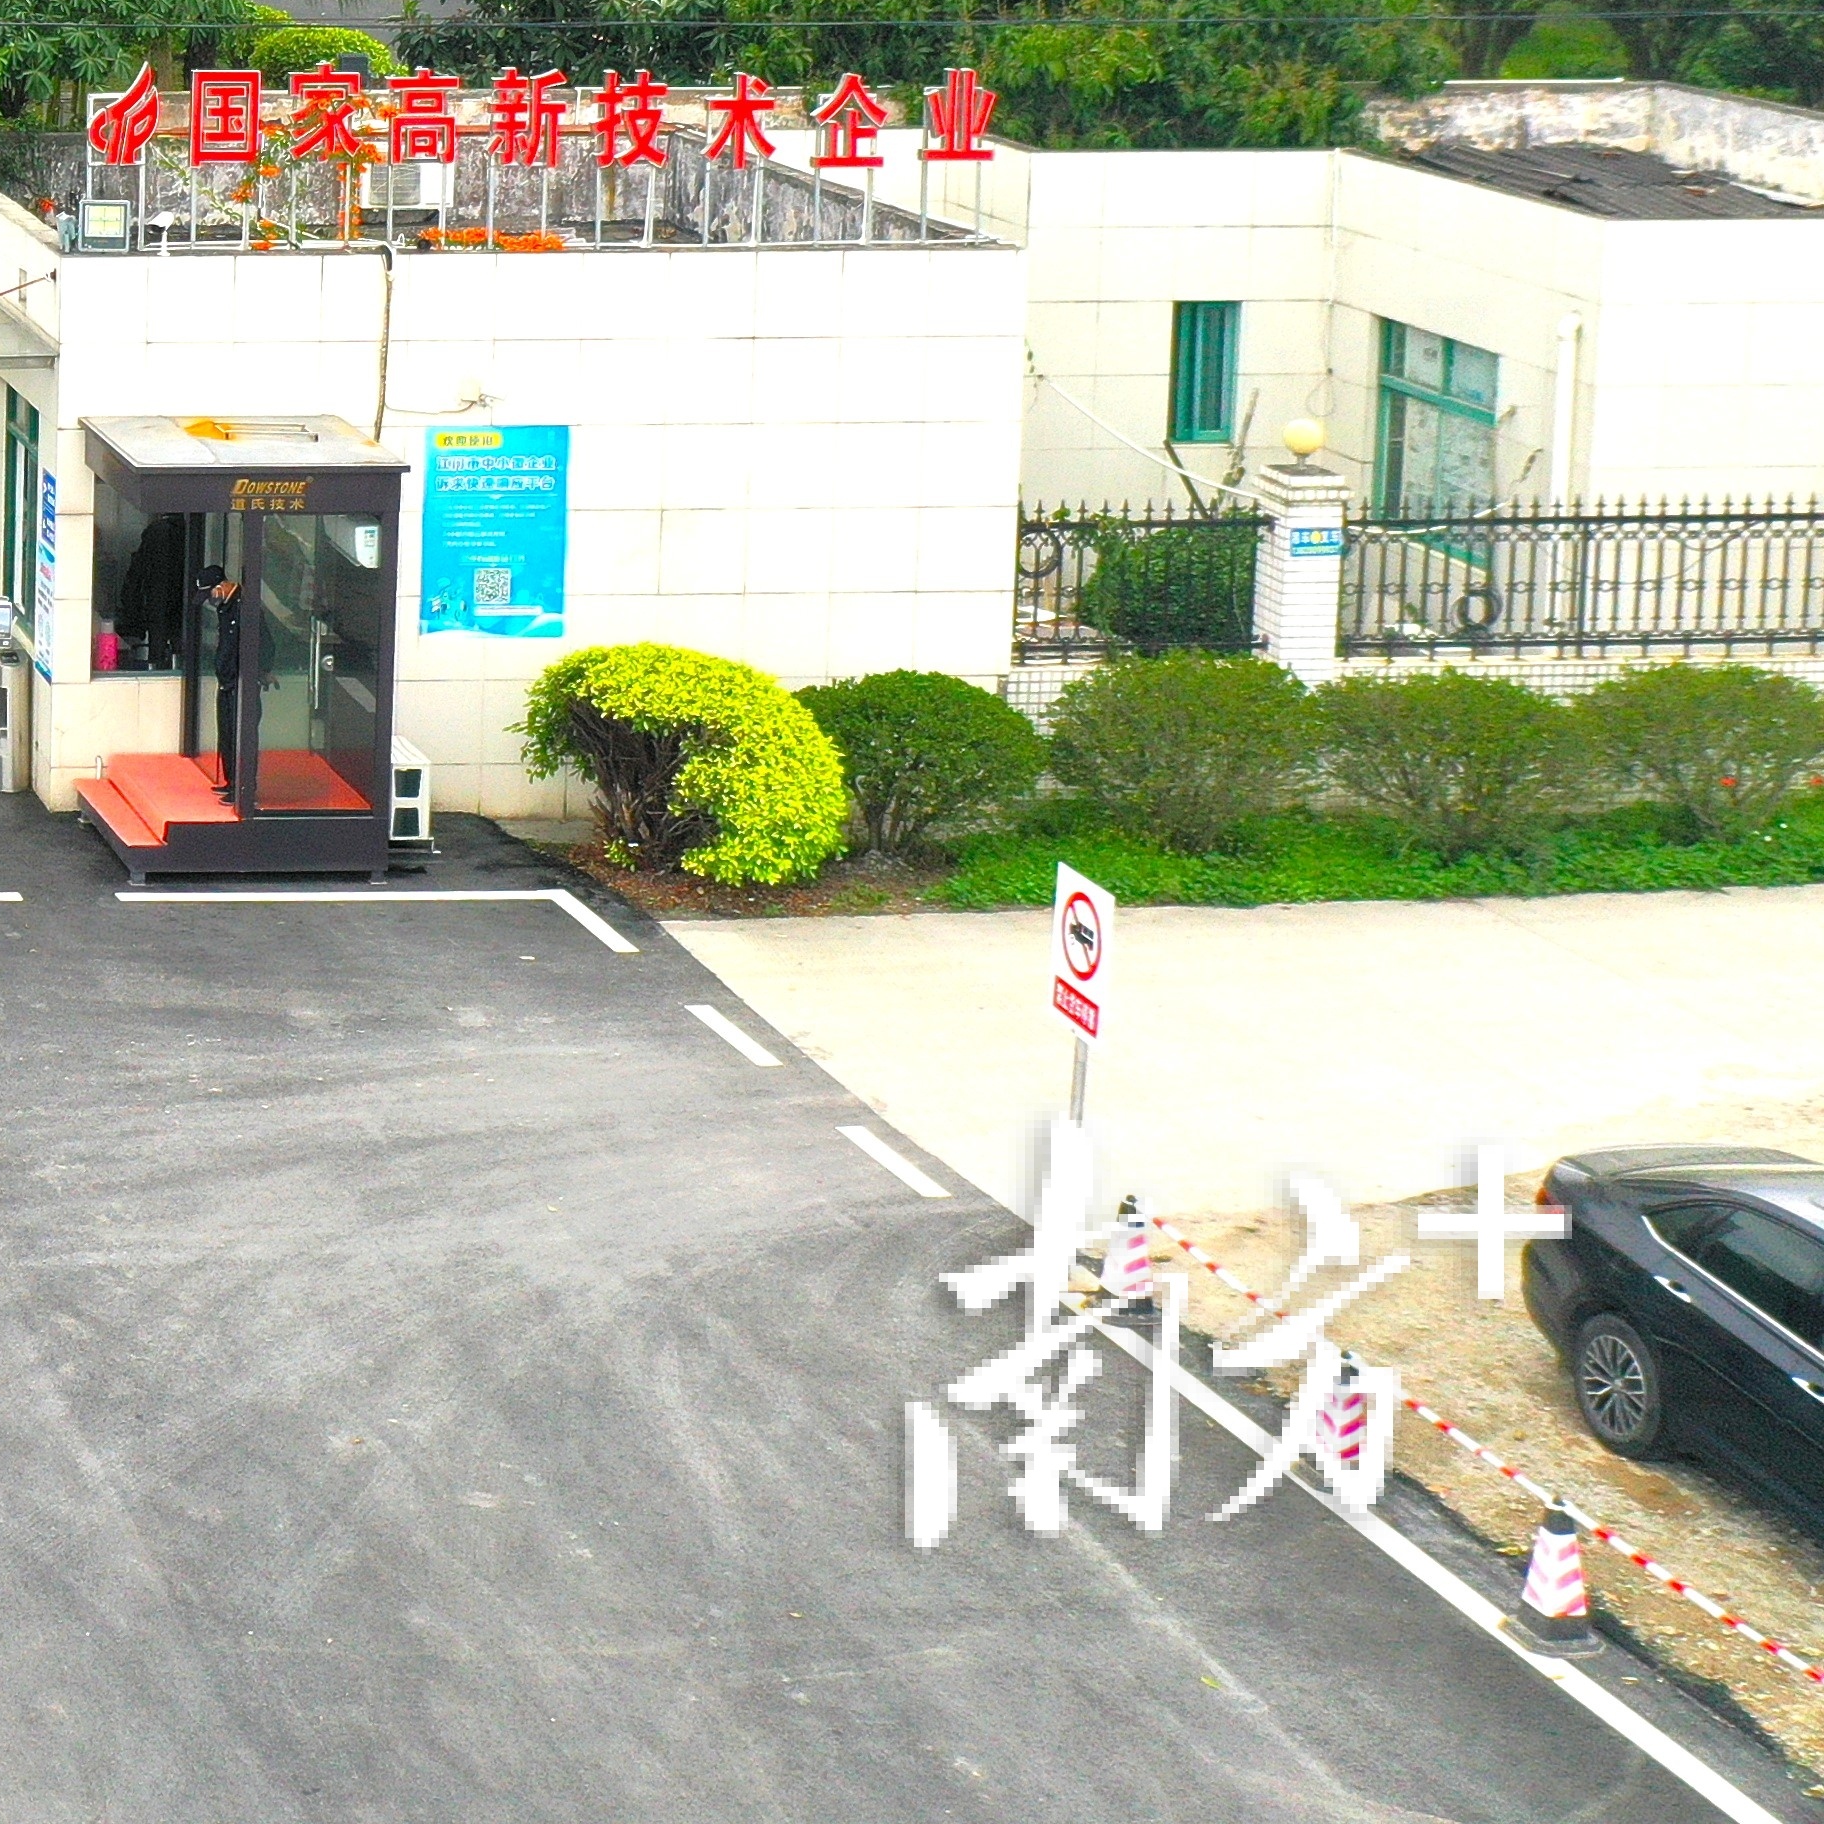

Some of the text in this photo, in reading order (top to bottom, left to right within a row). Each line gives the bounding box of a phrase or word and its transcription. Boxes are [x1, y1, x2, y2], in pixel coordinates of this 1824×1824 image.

[188, 63, 999, 170] 国家高新技术企业
[230, 478, 307, 495] DOWSTONE
[230, 498, 306, 512] 道氏技术
